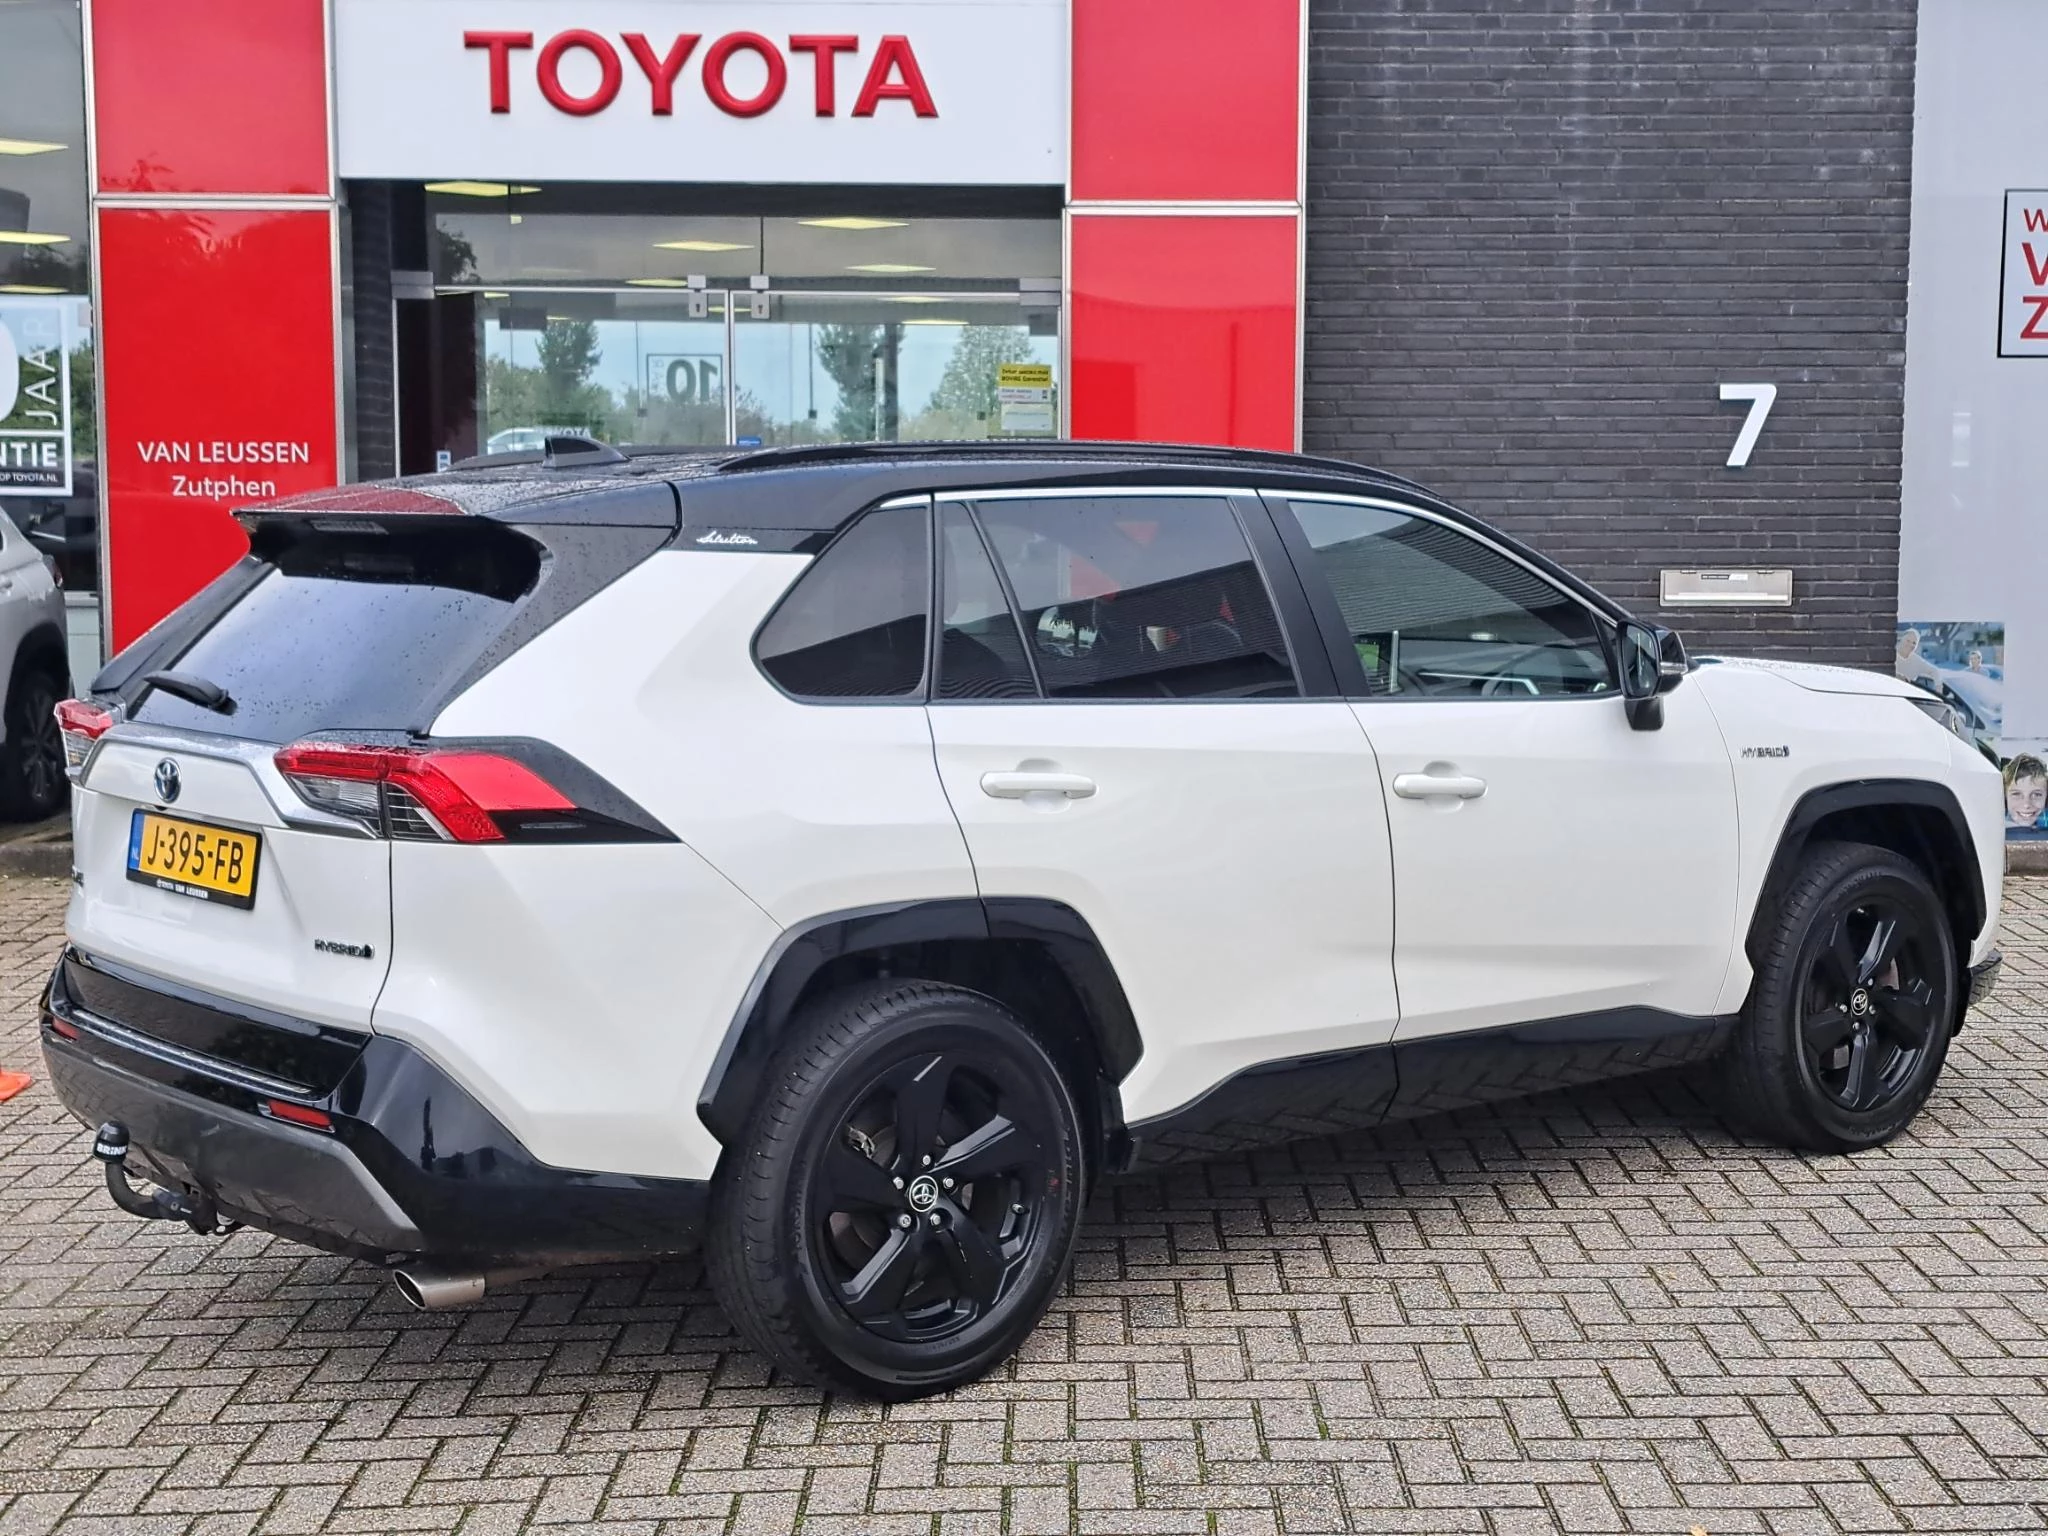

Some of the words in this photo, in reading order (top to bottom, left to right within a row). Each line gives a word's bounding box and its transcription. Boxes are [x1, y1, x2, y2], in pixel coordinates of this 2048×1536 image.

[463, 30, 939, 118] TOYOTA
[24, 319, 58, 425] JAAR
[1719, 383, 1777, 466] 7
[137, 441, 191, 463] VAN
[198, 442, 309, 464] LEUSSEN
[172, 475, 275, 500] Zutphen
[1740, 747, 1783, 758] HYBRID
[147, 825, 244, 884] J-395-FB
[314, 939, 362, 957] HYBRID
